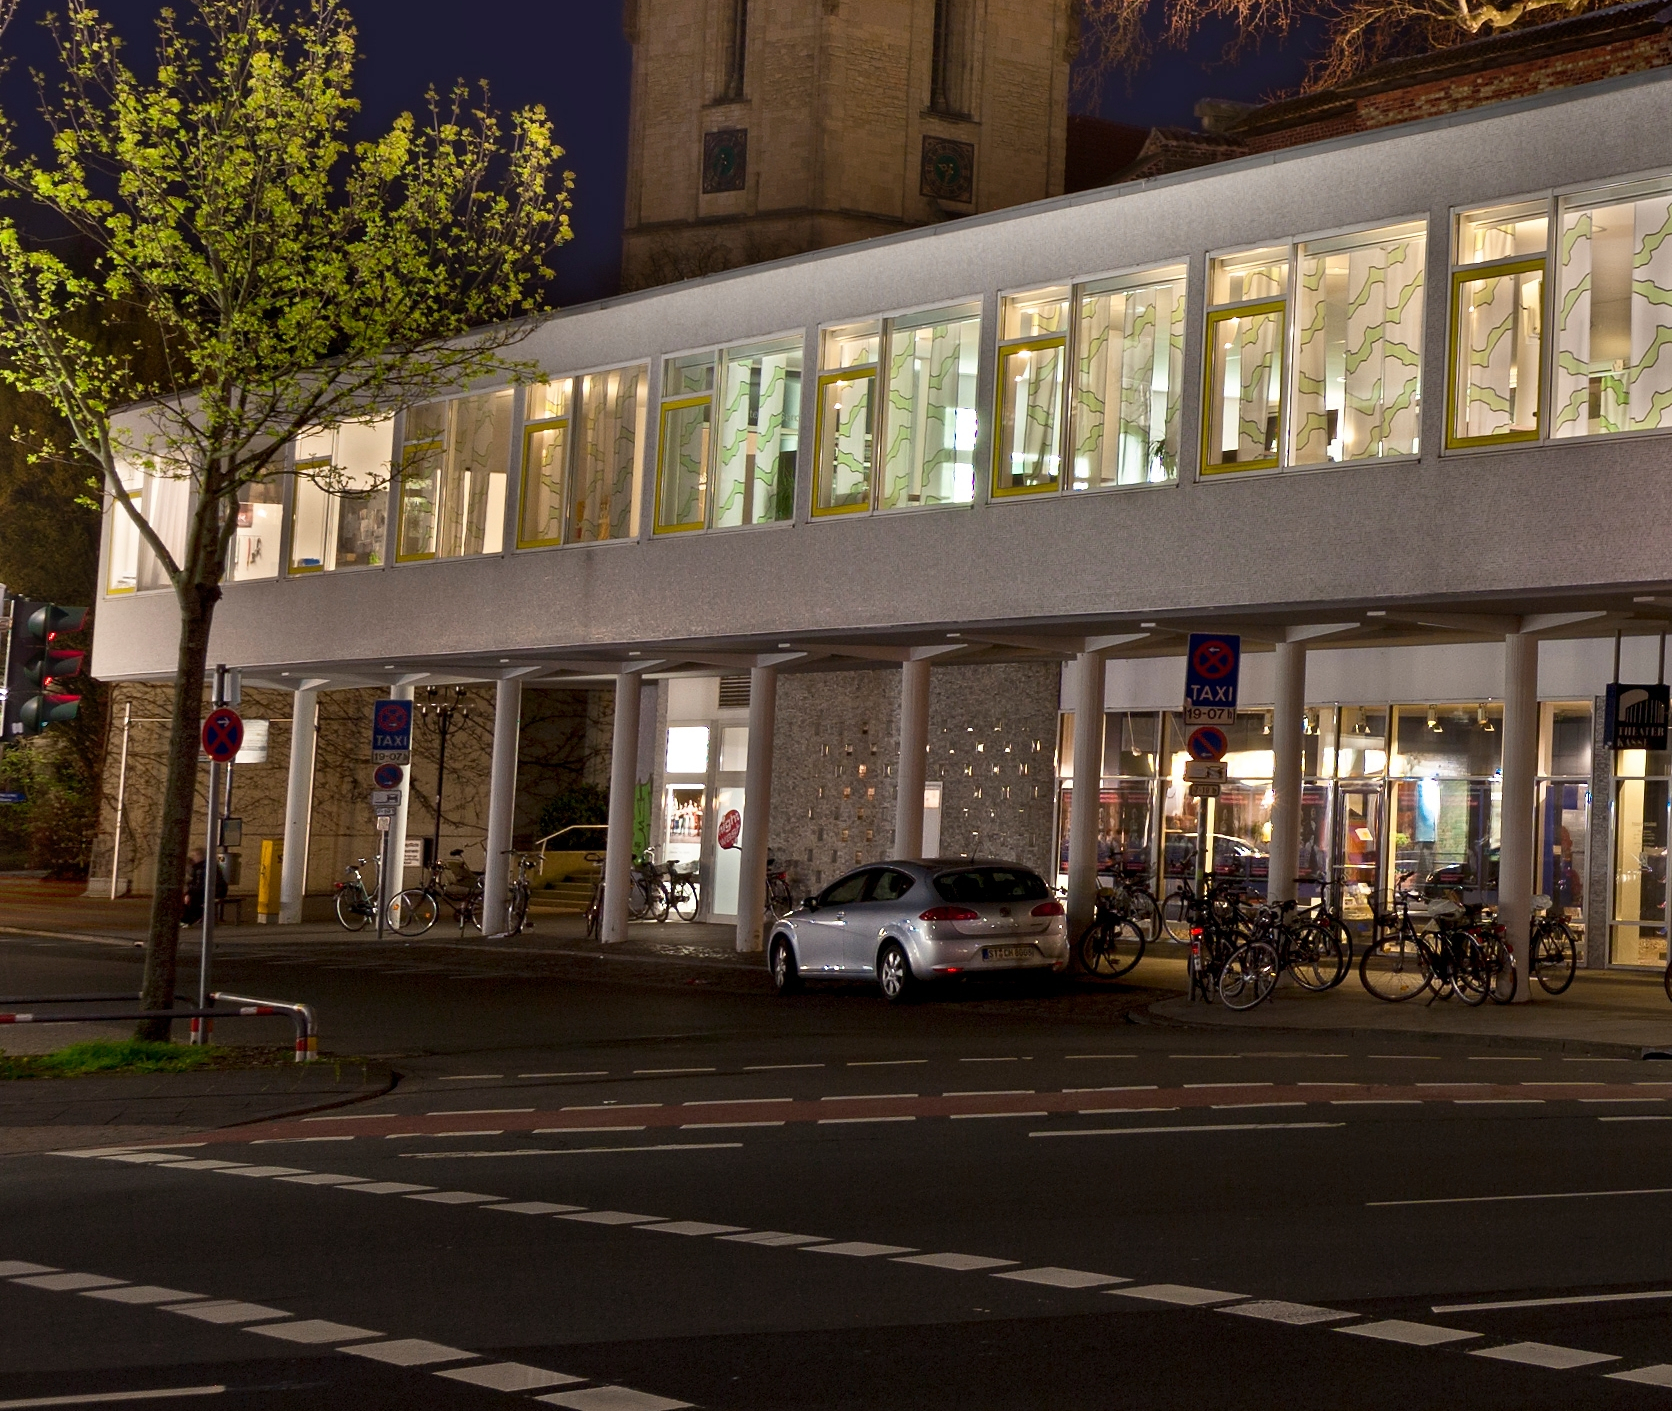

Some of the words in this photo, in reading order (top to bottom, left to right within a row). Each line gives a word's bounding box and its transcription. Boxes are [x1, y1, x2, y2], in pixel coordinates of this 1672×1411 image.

[1190, 685, 1233, 702] TAXI
[1187, 708, 1225, 720] 19-07
[1227, 708, 1232, 720] h
[1618, 726, 1664, 736] THEATER
[376, 734, 407, 746] TAXI
[1617, 737, 1648, 747] KASSE
[374, 752, 402, 761] 19-07
